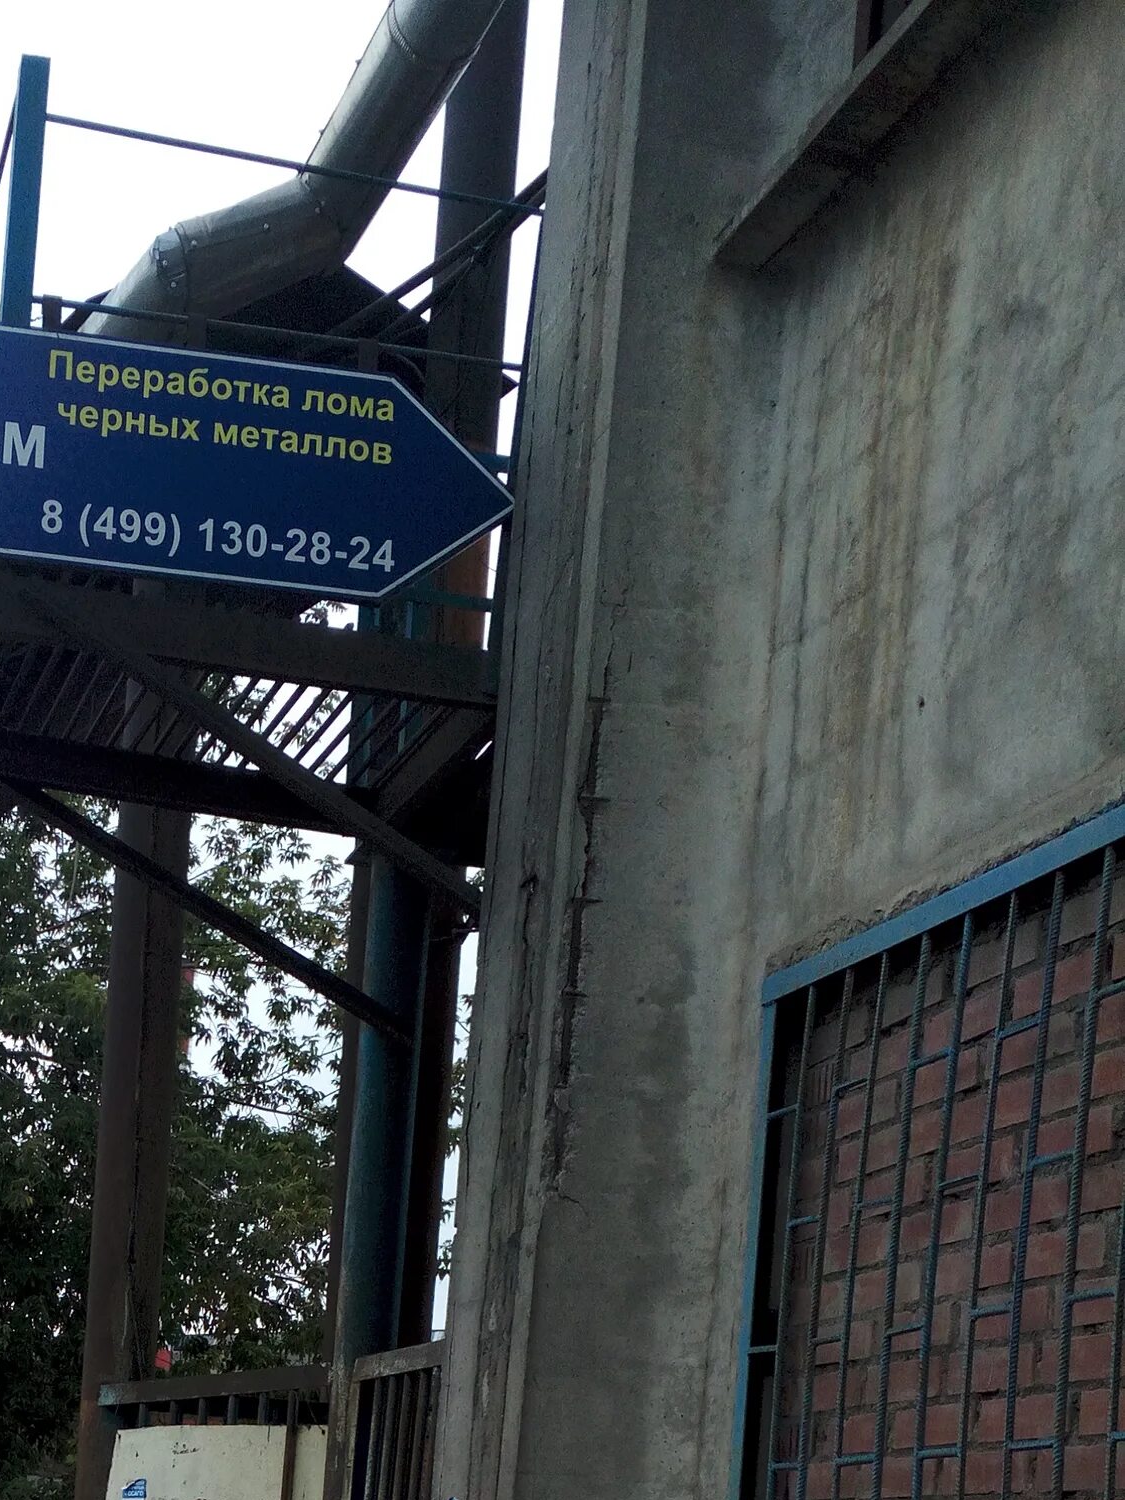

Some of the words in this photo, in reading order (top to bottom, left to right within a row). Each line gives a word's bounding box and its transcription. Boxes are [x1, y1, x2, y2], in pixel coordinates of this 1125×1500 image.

[48, 349, 290, 409] Переработка
[301, 389, 395, 422] лома
[57, 402, 200, 442] черных
[213, 422, 393, 465] металлов
[40, 499, 63, 534] 8
[79, 503, 181, 557] (499)
[198, 518, 396, 573] 130-28-24
